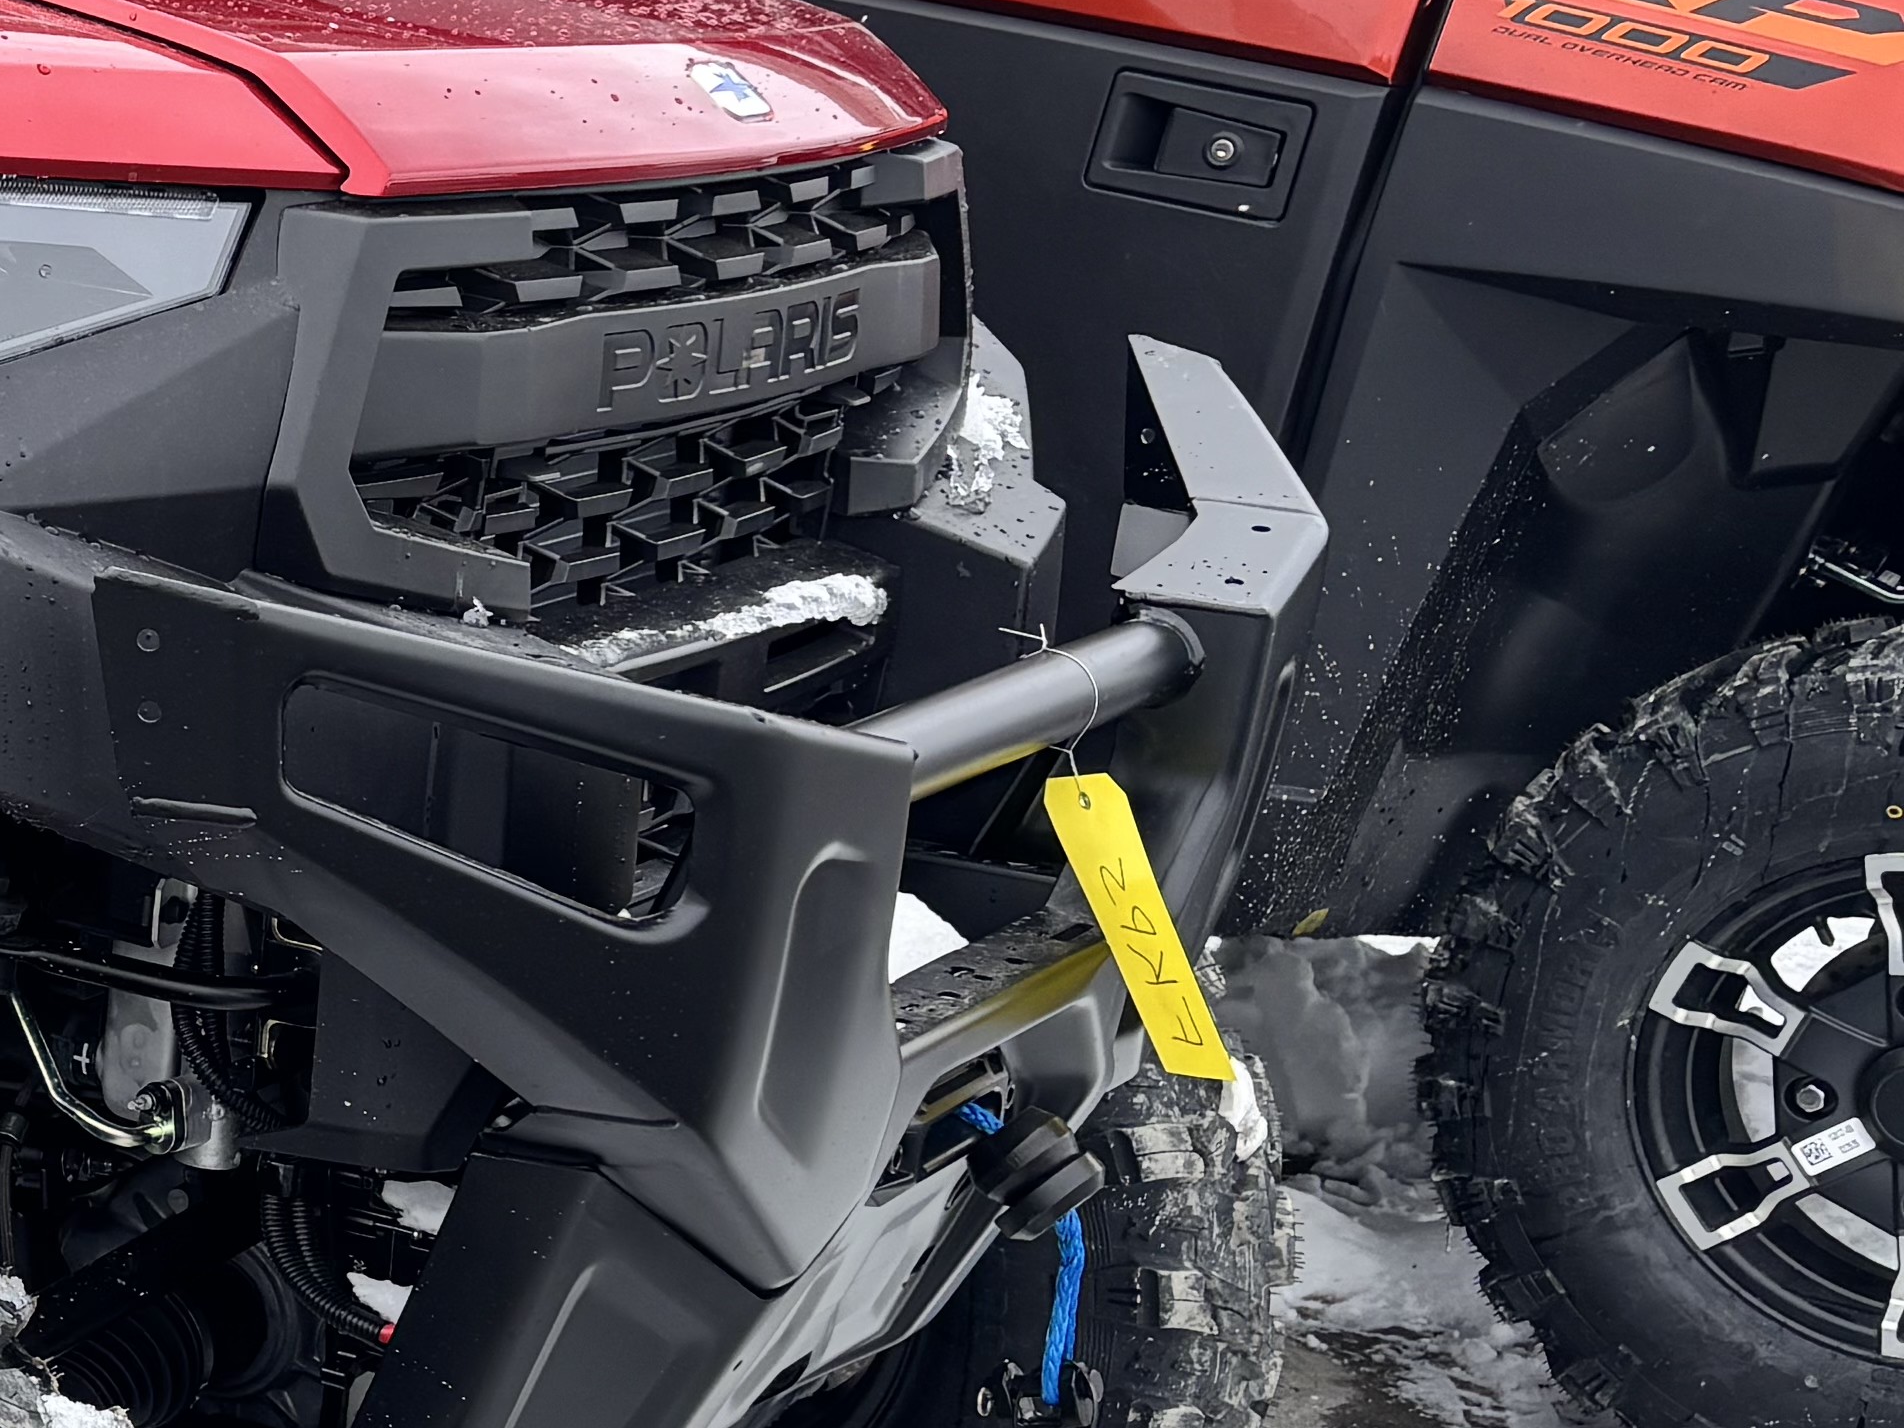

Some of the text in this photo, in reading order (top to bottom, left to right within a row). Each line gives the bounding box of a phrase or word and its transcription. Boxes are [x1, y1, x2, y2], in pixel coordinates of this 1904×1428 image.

[1491, 25, 1748, 92] DUAL OVERHEAD CAM
[594, 288, 860, 413] POLARIS
